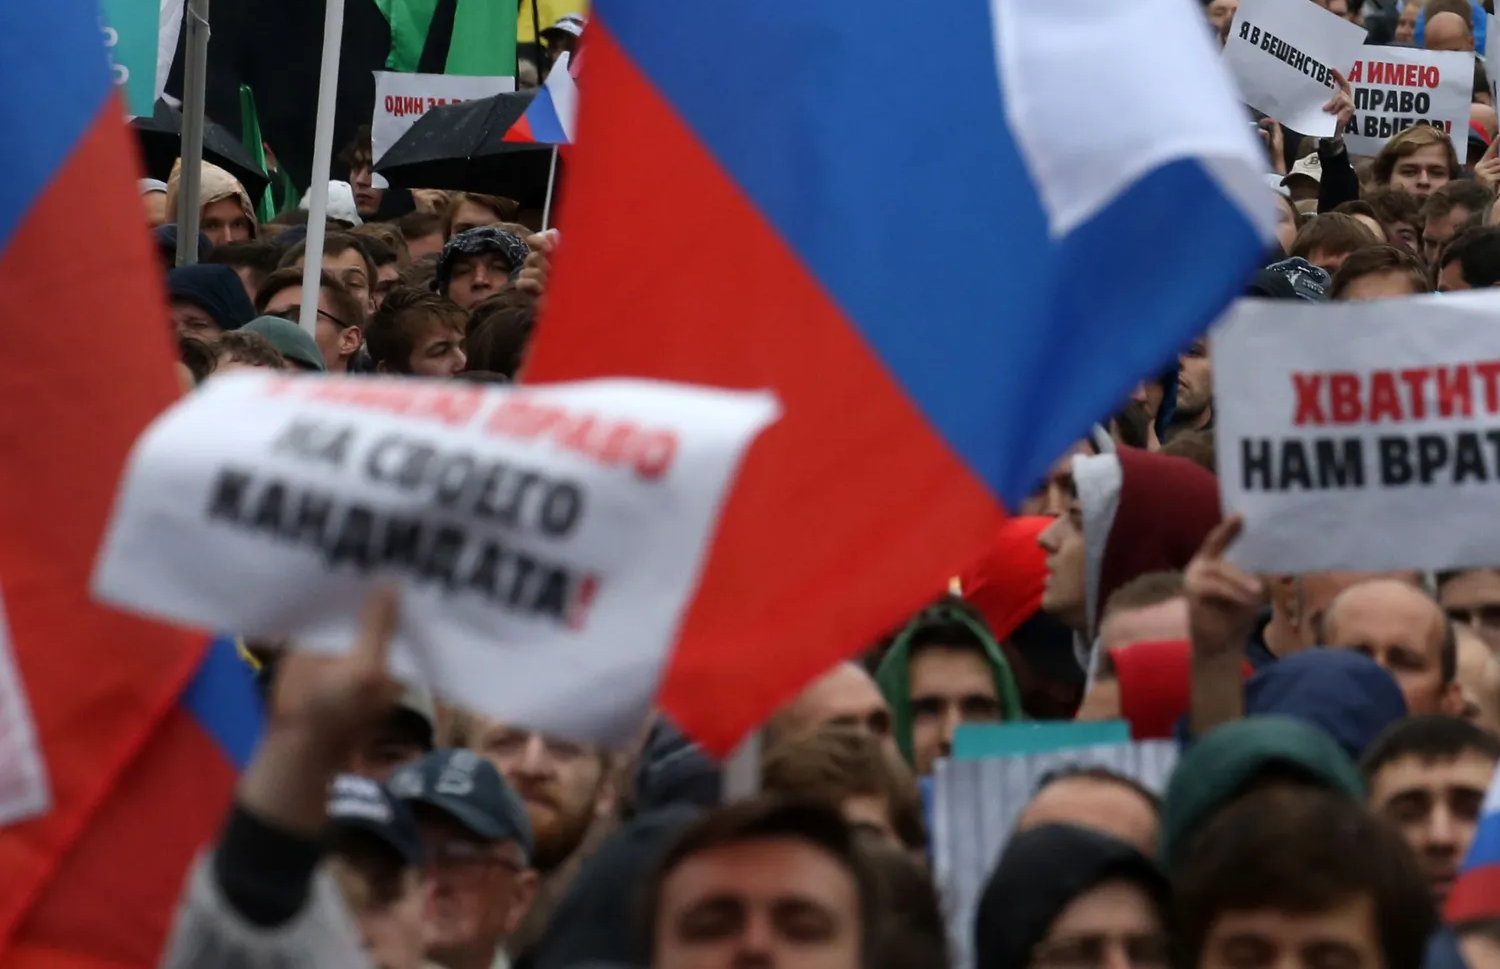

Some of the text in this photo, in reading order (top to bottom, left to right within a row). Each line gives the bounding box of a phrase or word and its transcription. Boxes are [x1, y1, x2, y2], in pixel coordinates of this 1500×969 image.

[1239, 21, 1251, 40] Я
[1250, 28, 1261, 46] В
[1367, 61, 1440, 88] ИМЕЮ
[385, 95, 424, 117] ОДИН
[1354, 88, 1430, 114] ПРАВО
[1346, 114, 1361, 136] А
[1241, 437, 1366, 492] НАМ
[366, 431, 586, 536] СВОЕГО
[207, 462, 600, 630] КАНДИДАТА!
